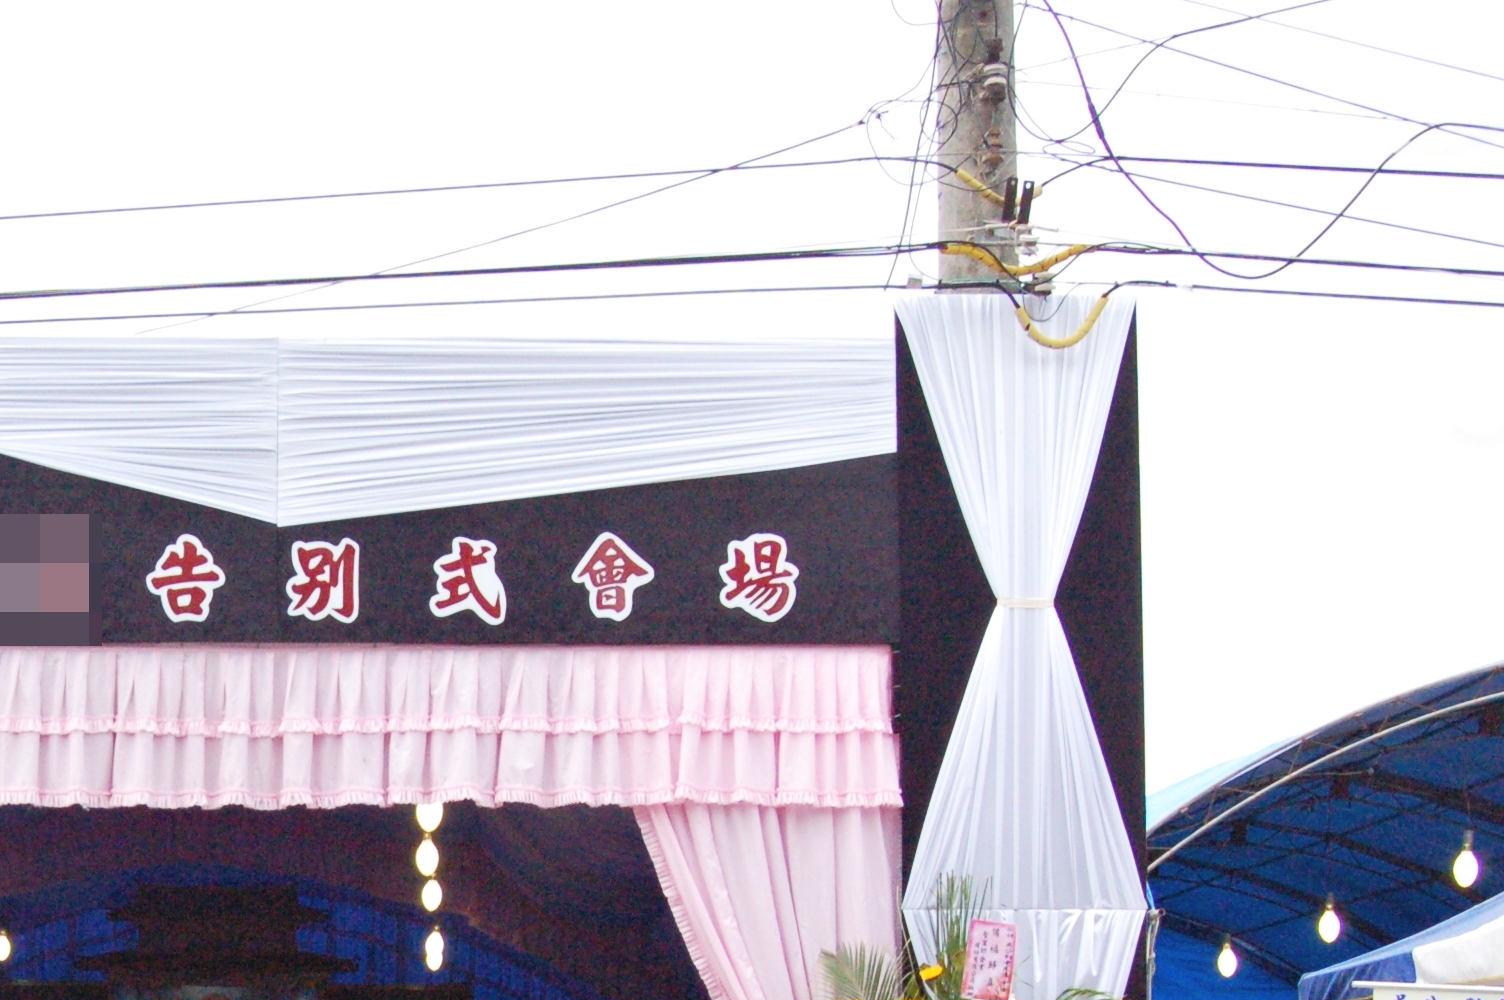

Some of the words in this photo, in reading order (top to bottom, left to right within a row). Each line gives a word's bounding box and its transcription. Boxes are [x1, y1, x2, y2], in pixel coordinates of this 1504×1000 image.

[146, 533, 799, 624] 告別式會場
